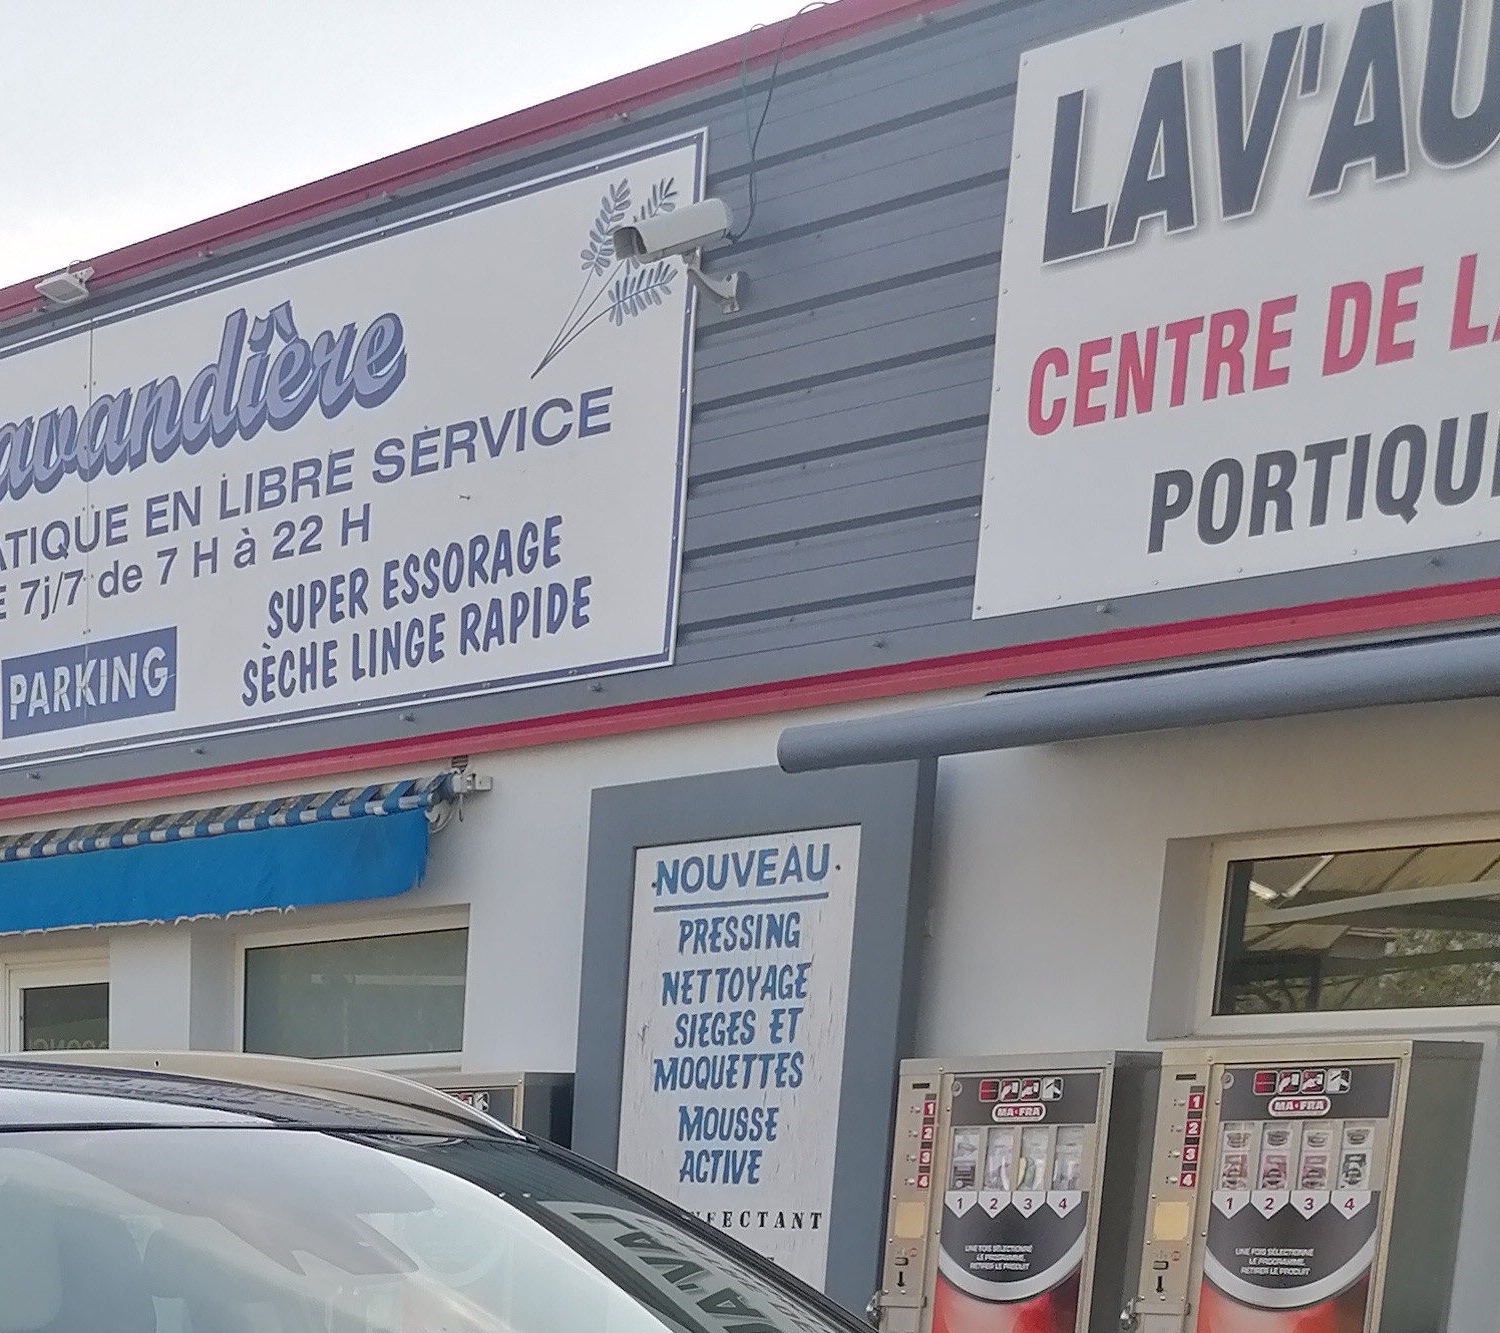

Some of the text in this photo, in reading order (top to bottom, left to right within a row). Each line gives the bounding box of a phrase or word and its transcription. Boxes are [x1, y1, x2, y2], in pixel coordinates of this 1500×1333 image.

[1027, 253, 1500, 436] CENTRE DE L
[146, 486, 202, 538] EN
[219, 448, 355, 521] LIBRE
[372, 387, 614, 484] SERVICE
[1147, 411, 1500, 555] PORTIQU
[20, 569, 84, 620] 7j/7
[99, 561, 143, 598] de
[157, 548, 178, 585] 7
[193, 538, 219, 577] H
[234, 528, 256, 568] à
[273, 516, 323, 561] 22
[341, 503, 371, 546] H
[267, 515, 563, 638] SUPER ESSORAGE
[242, 576, 592, 706] SÈCHE LINGE RAPIDE
[9, 641, 171, 722] PARKING
[656, 844, 830, 896] NOUVEAU
[678, 912, 801, 954] PRESSING
[662, 962, 812, 1007] NETTOYAGE
[674, 1007, 803, 1048] SIEGES ET
[653, 1051, 804, 1093] MOQUETTES
[927, 1102, 935, 1115] 1
[1192, 1095, 1201, 1109] 1
[679, 1106, 780, 1142] MOUSSE
[923, 1127, 932, 1140] 2
[1188, 1122, 1198, 1135] 2
[680, 1149, 763, 1184] ACTIVE
[921, 1152, 931, 1164] 3
[1185, 1148, 1196, 1161] 3
[919, 1175, 929, 1187] 4
[1182, 1174, 1193, 1187] 4
[691, 1211, 822, 1229] FECTANT
[957, 1198, 1068, 1210] 1 2 3 4
[1226, 1197, 1355, 1211] 1 2 3 4
